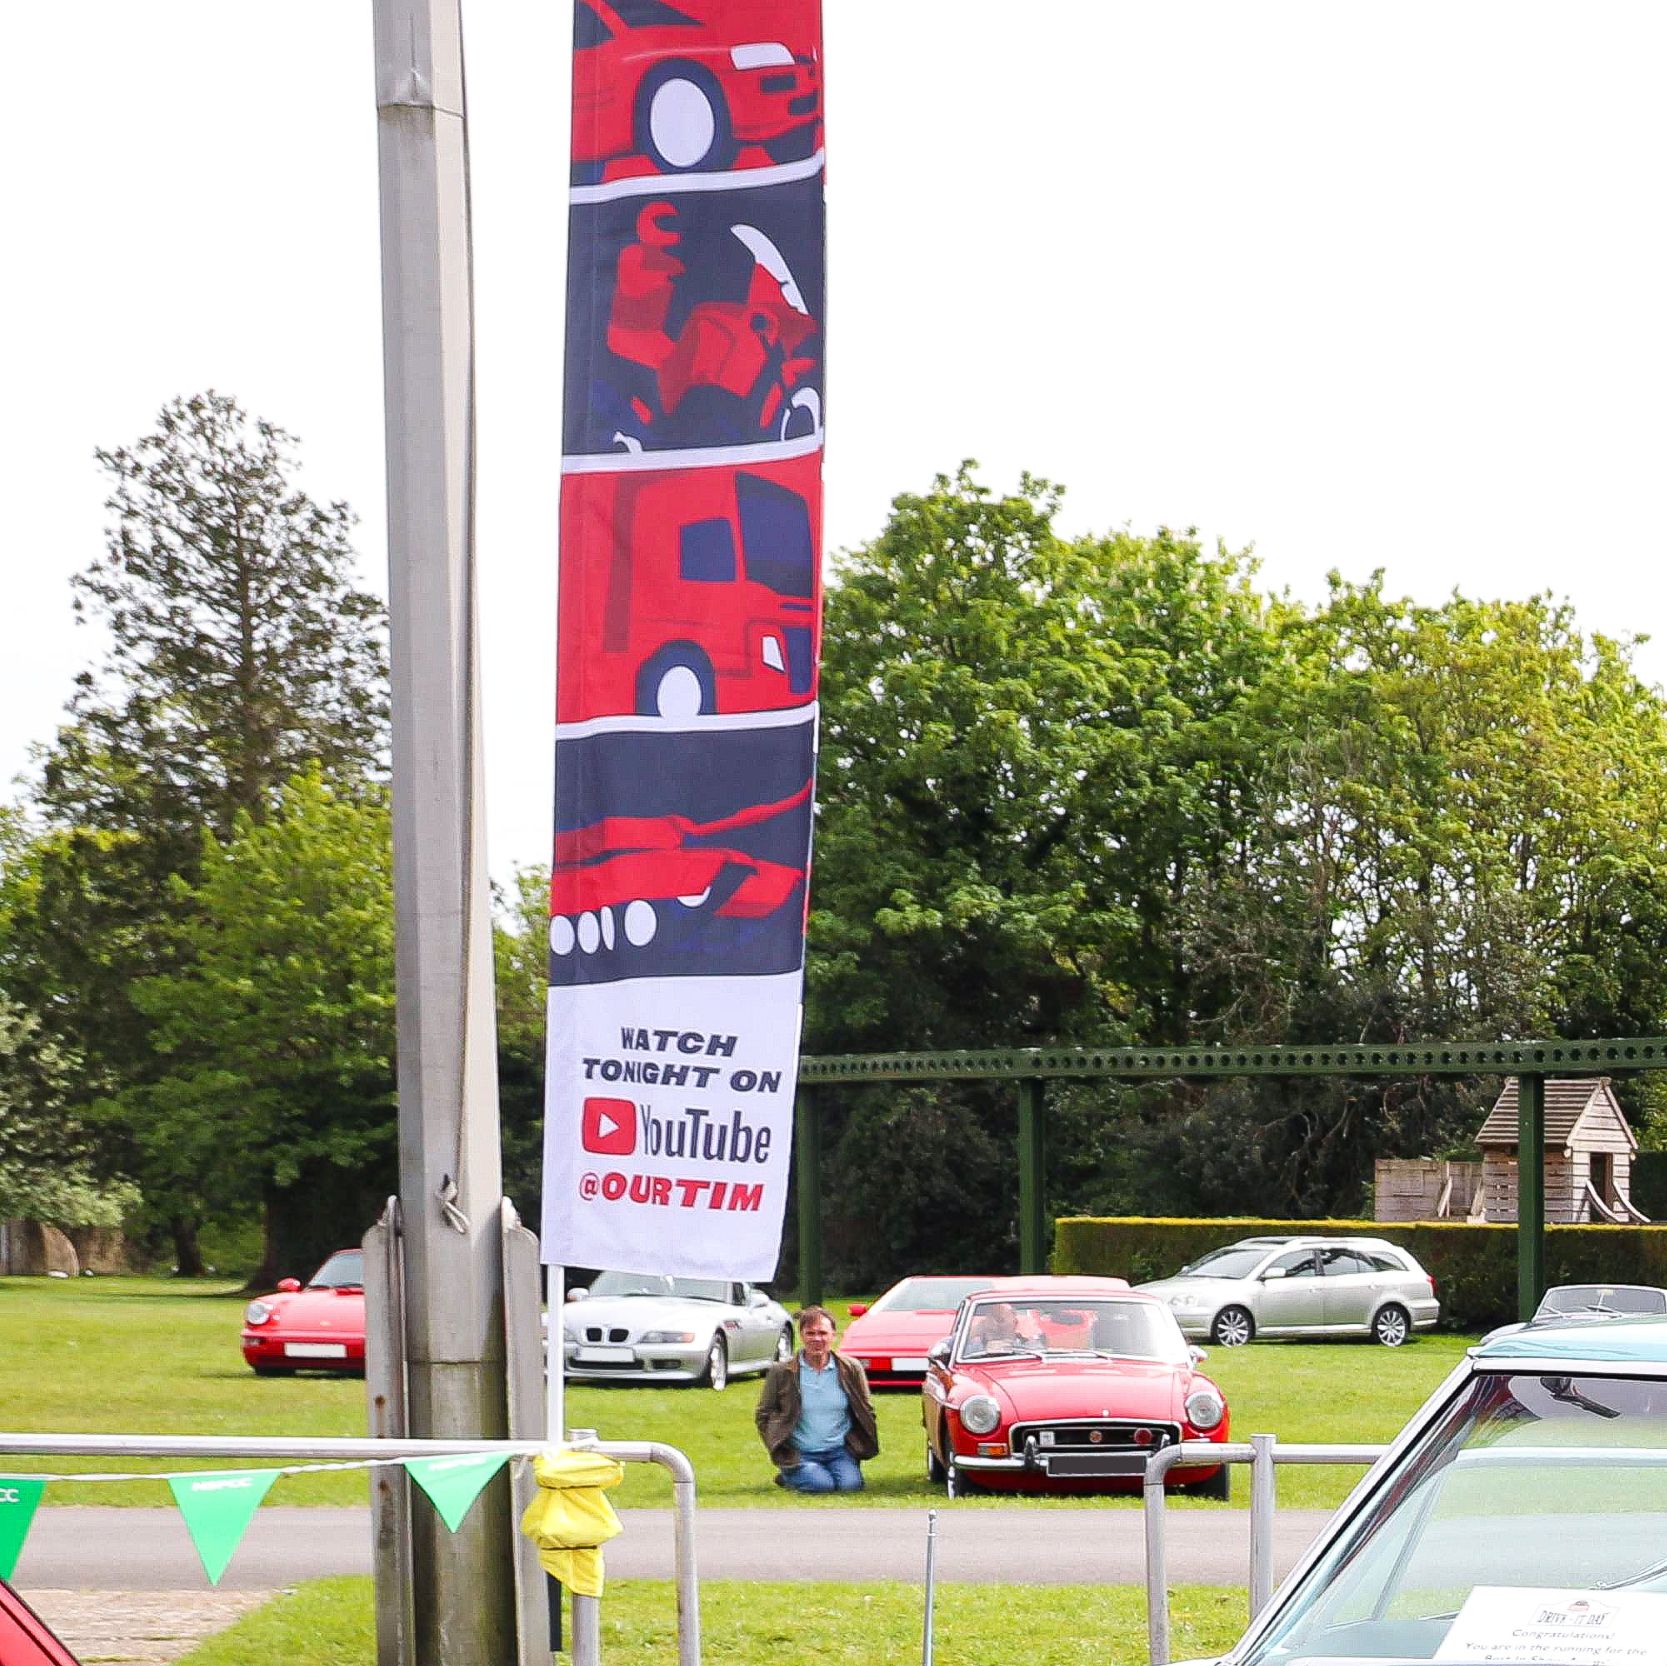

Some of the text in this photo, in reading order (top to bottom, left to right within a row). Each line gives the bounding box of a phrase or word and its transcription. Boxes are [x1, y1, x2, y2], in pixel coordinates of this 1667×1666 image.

[620, 1026, 738, 1057] WATCH
[582, 1058, 783, 1093] TONIGHT ON
[639, 1103, 772, 1164] YouTube
[579, 1171, 766, 1211] @OURTIM
